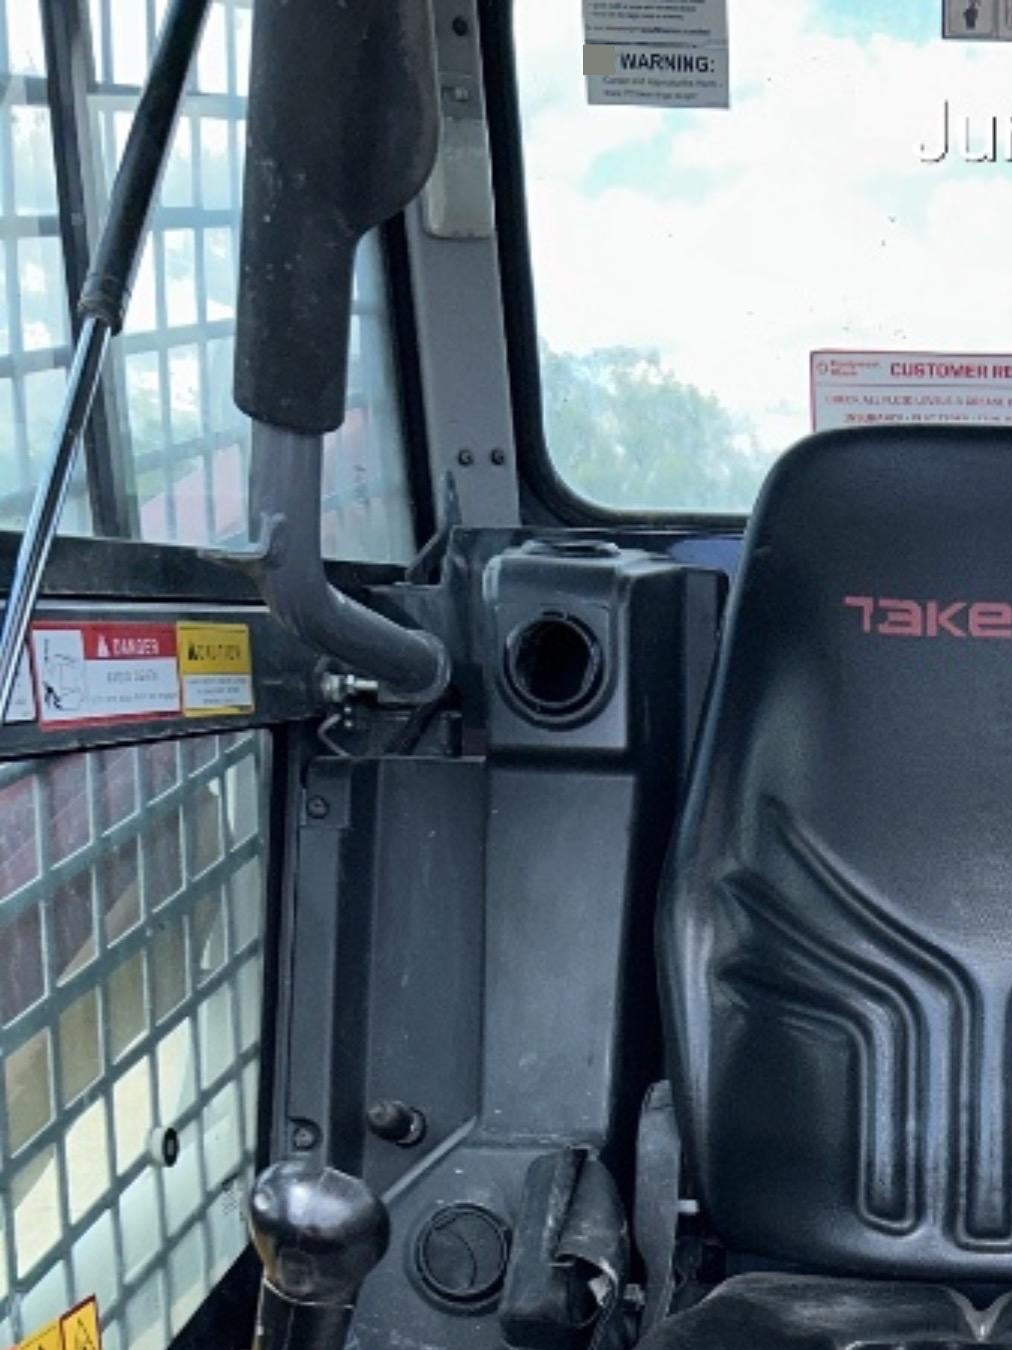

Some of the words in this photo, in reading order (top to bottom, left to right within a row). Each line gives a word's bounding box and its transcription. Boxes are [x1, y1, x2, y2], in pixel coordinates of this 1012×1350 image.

[620, 52, 716, 73] WARNING:
[890, 362, 989, 380] CUSTOMER
[112, 637, 160, 656] DANGER
